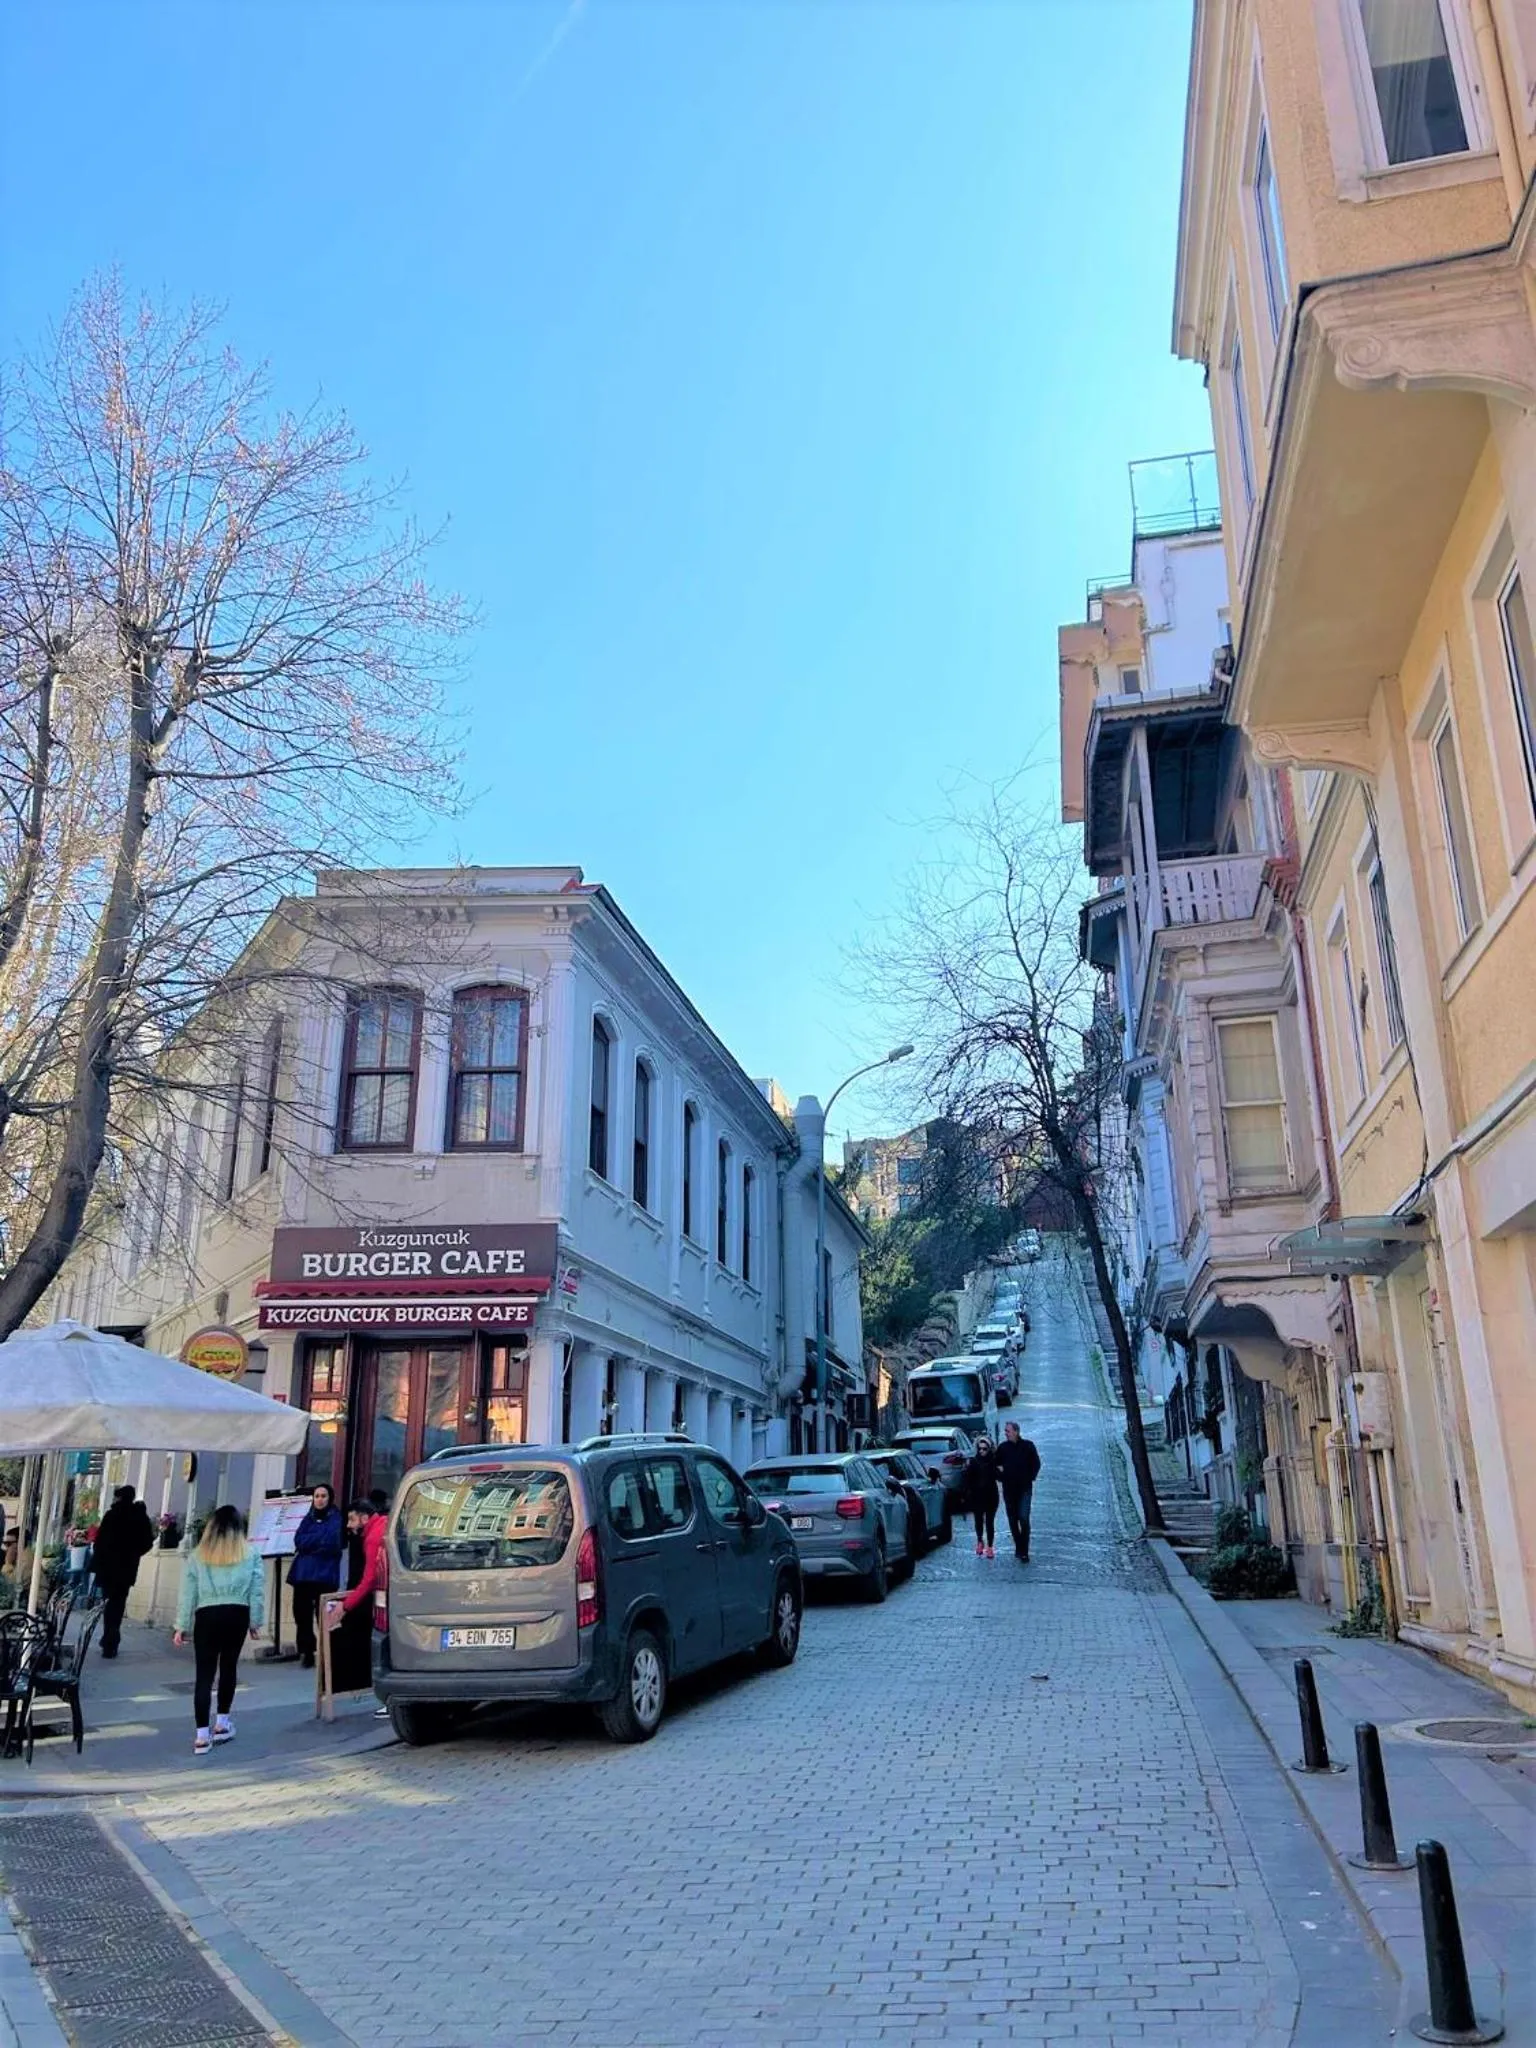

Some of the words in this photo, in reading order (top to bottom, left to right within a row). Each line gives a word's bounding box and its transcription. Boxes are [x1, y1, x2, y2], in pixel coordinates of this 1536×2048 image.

[359, 1229, 470, 1249] Kuzguncuk
[302, 1252, 432, 1277] BURGER
[440, 1249, 525, 1275] CAFE
[266, 1307, 390, 1323] KUZGUNCUK
[394, 1306, 473, 1322] BURGER
[477, 1306, 528, 1321] CAFE
[449, 1631, 461, 1645] 34
[492, 1629, 512, 1644] 765
